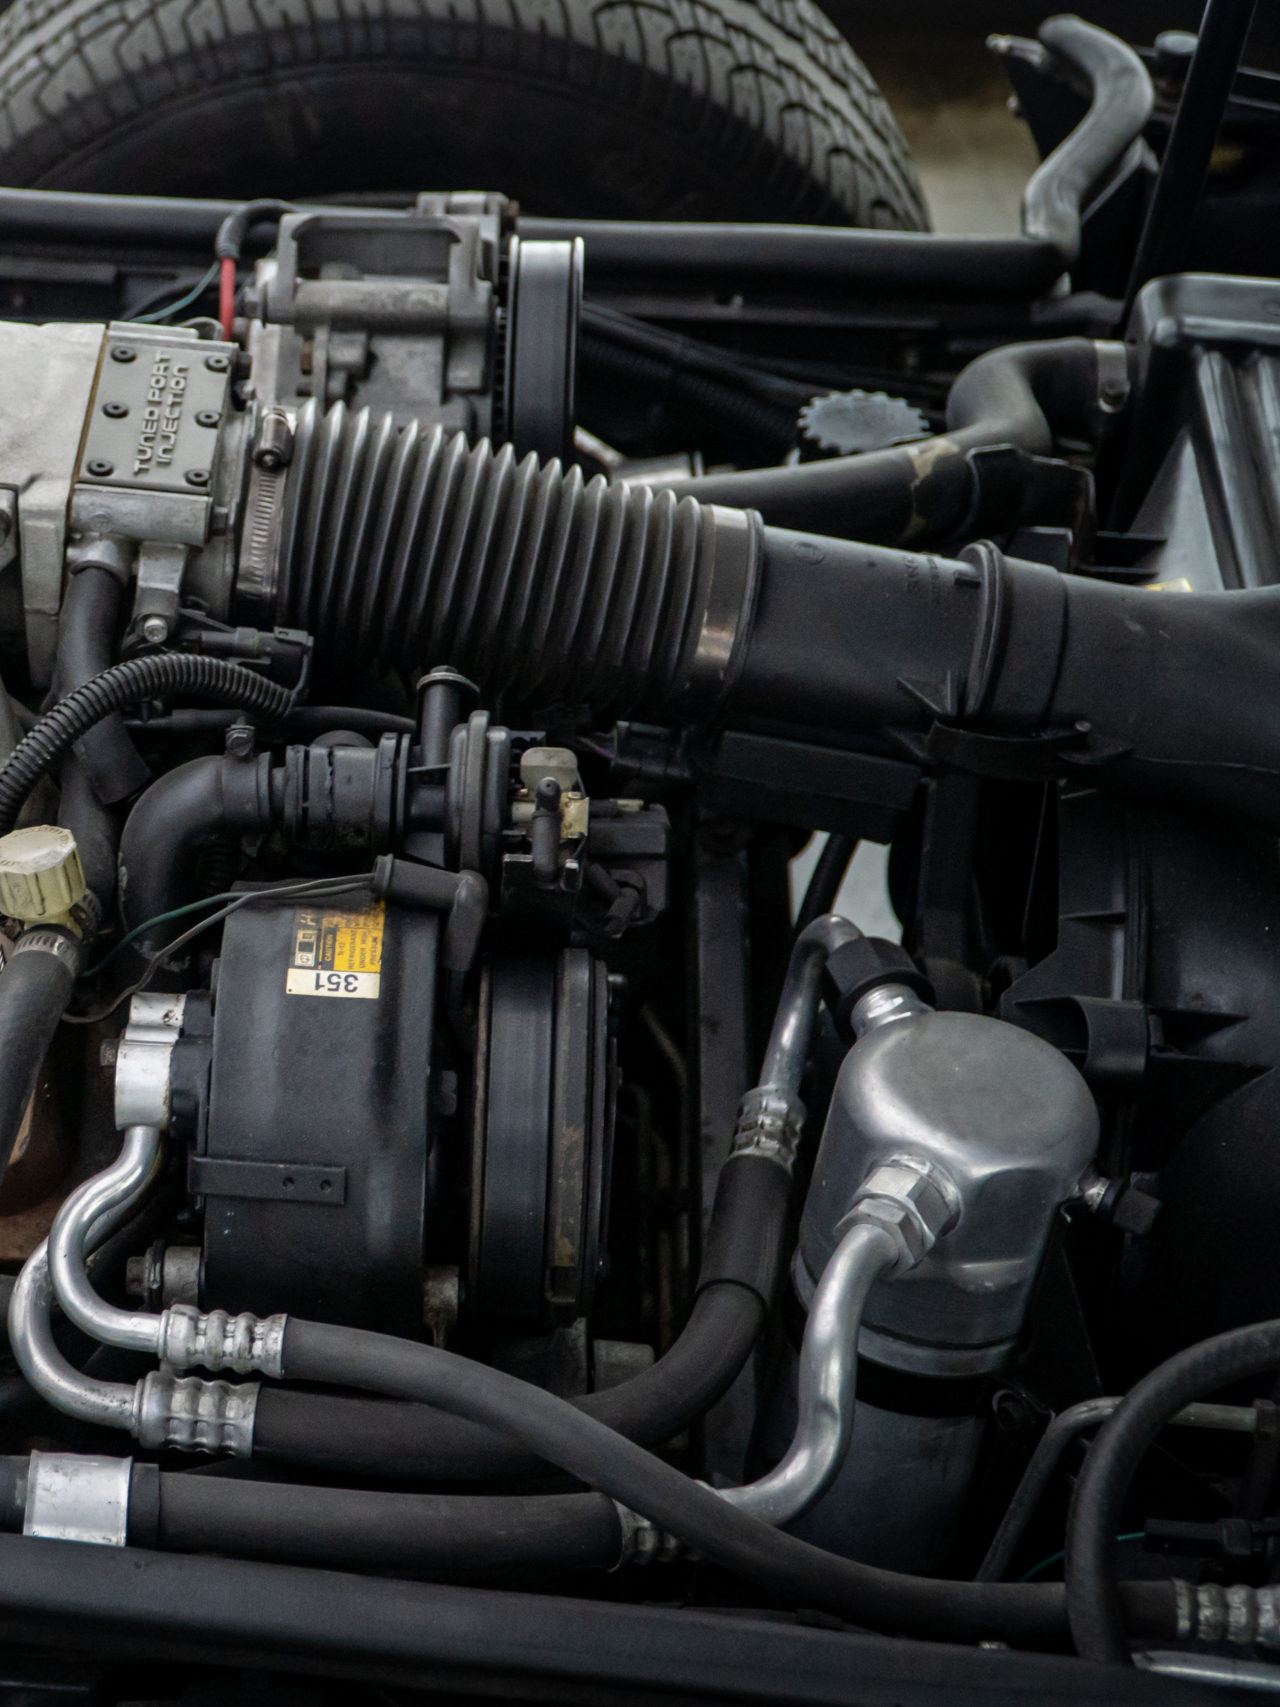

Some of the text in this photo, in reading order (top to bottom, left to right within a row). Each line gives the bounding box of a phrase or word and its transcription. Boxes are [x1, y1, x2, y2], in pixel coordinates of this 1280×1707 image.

[134, 350, 171, 476] TUNED PORT
[156, 364, 190, 466] INJECTION
[315, 972, 359, 993] 351
